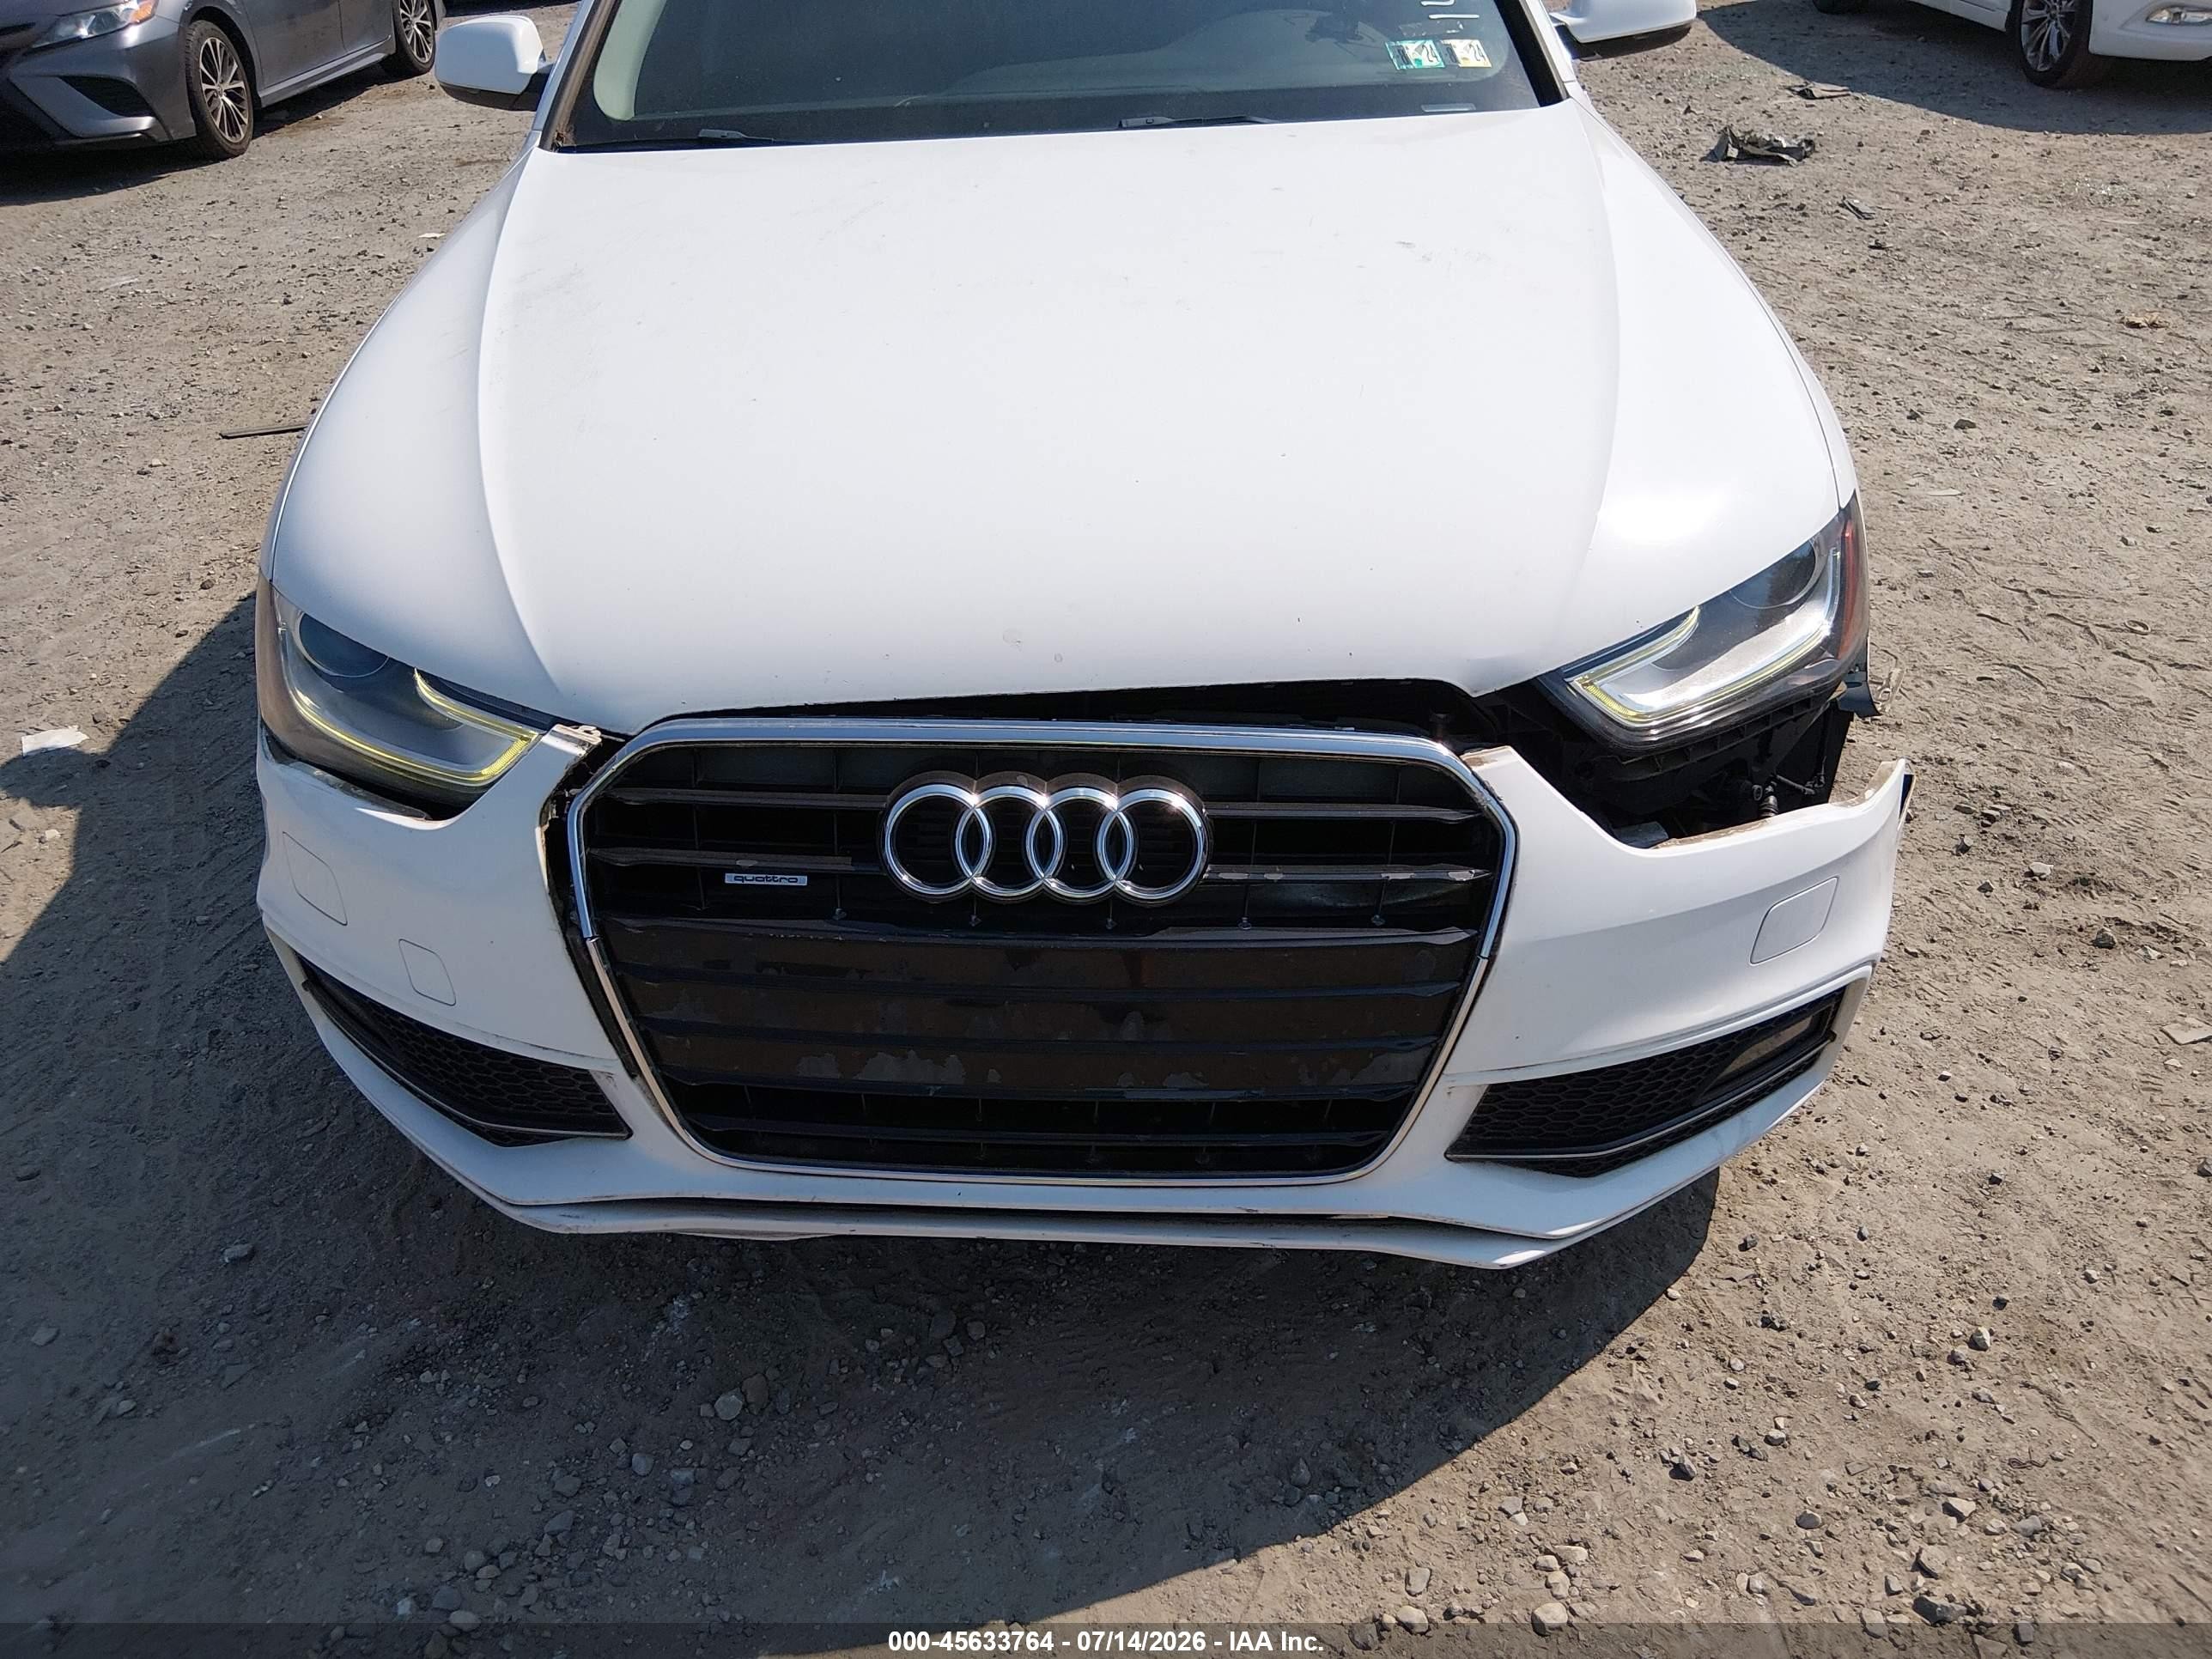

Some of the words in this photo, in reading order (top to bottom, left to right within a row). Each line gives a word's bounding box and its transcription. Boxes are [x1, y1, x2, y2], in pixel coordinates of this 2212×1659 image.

[1422, 44, 1441, 63] 24
[1469, 43, 1487, 62] 24
[733, 875, 799, 884] quattro
